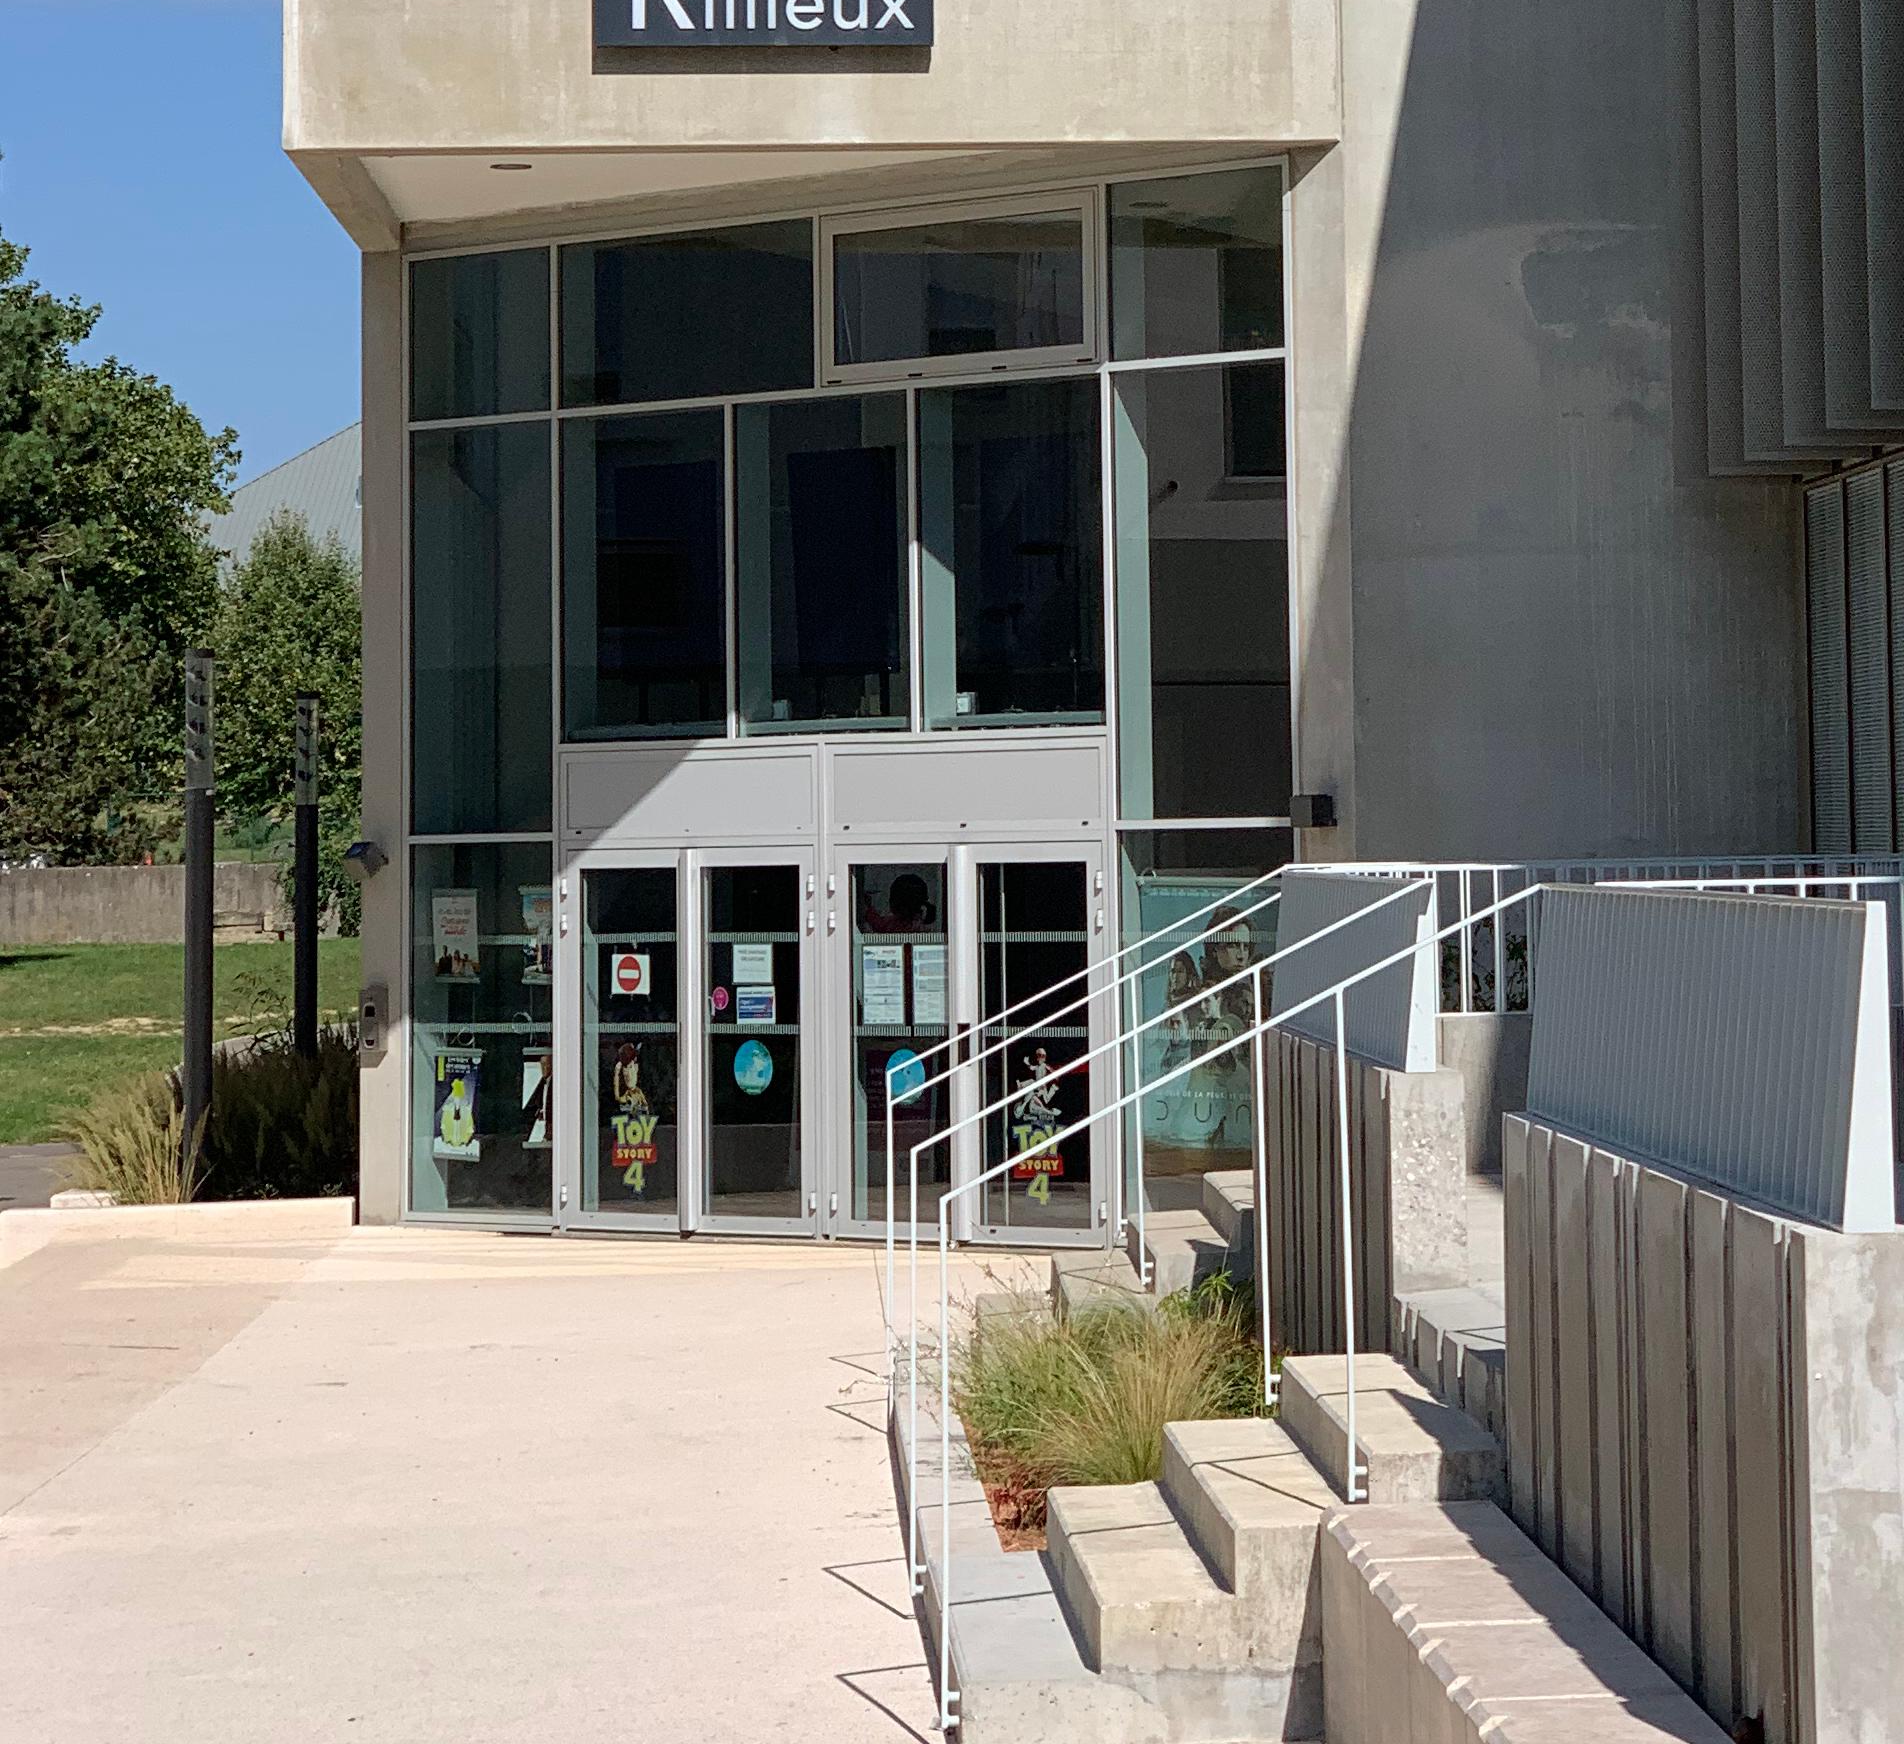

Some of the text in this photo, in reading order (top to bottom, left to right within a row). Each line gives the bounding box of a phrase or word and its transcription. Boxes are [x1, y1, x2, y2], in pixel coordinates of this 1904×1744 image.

[1155, 1100, 1252, 1124] DUN
[611, 1115, 660, 1146] TOY
[1012, 1124, 1066, 1156] TOY
[616, 1148, 653, 1159] STORY
[1018, 1159, 1060, 1171] STORY
[623, 1160, 646, 1193] 4
[1027, 1172, 1051, 1206] 4
